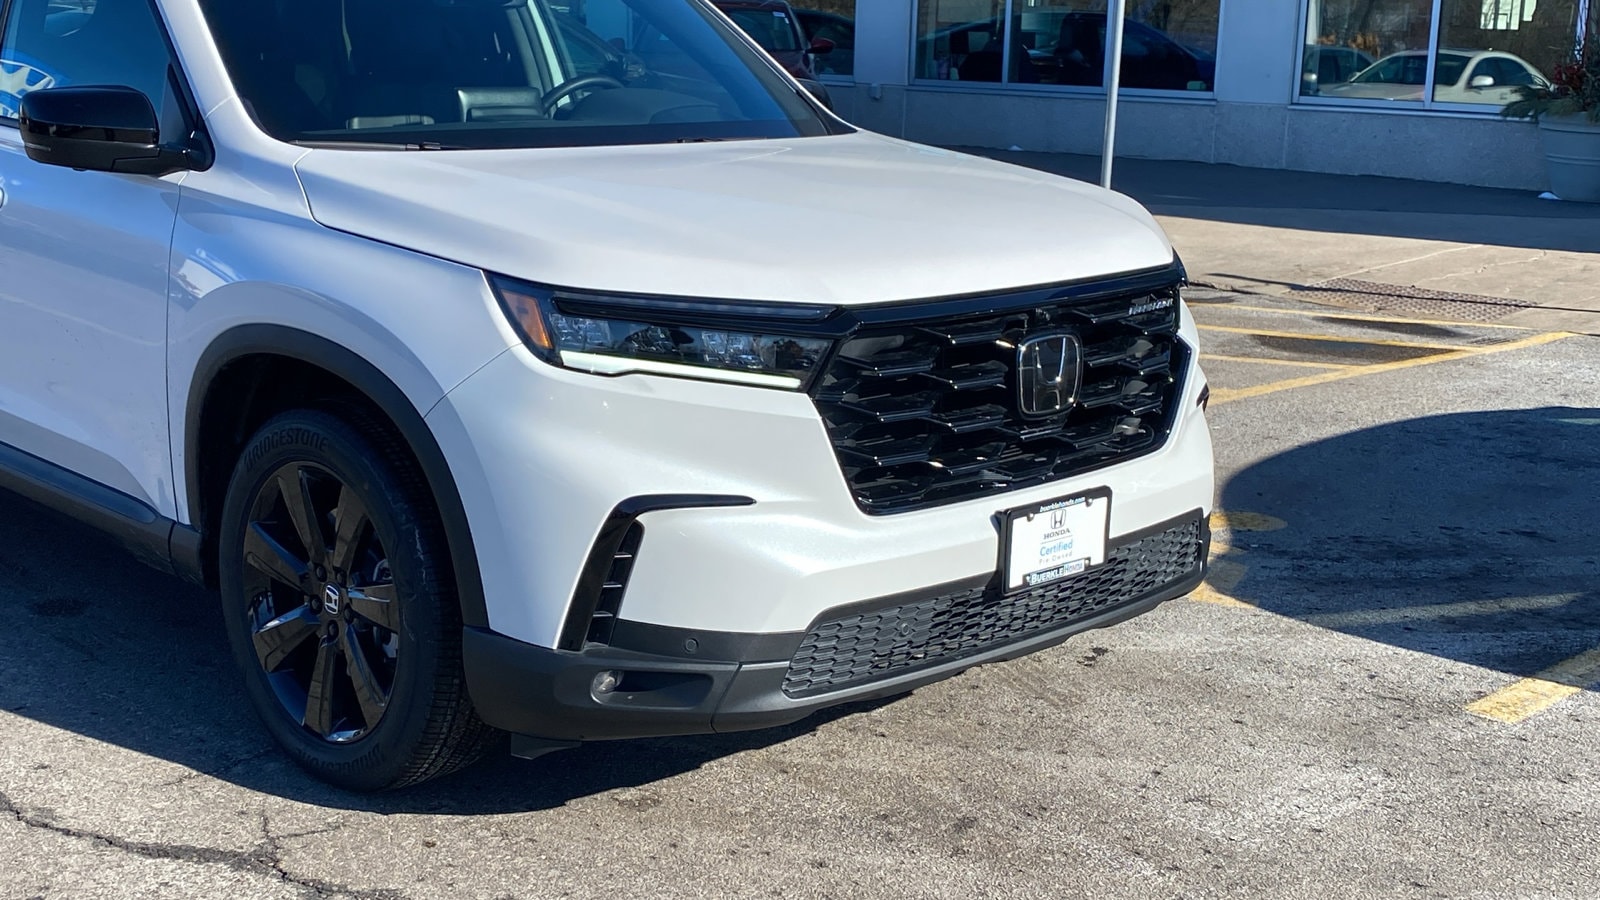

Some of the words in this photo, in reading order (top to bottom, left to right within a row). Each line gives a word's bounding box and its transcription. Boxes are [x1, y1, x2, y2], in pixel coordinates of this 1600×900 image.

[243, 427, 329, 472] BRIDGESTONE
[1043, 527, 1071, 540] HONDA
[1040, 539, 1074, 557] Certified
